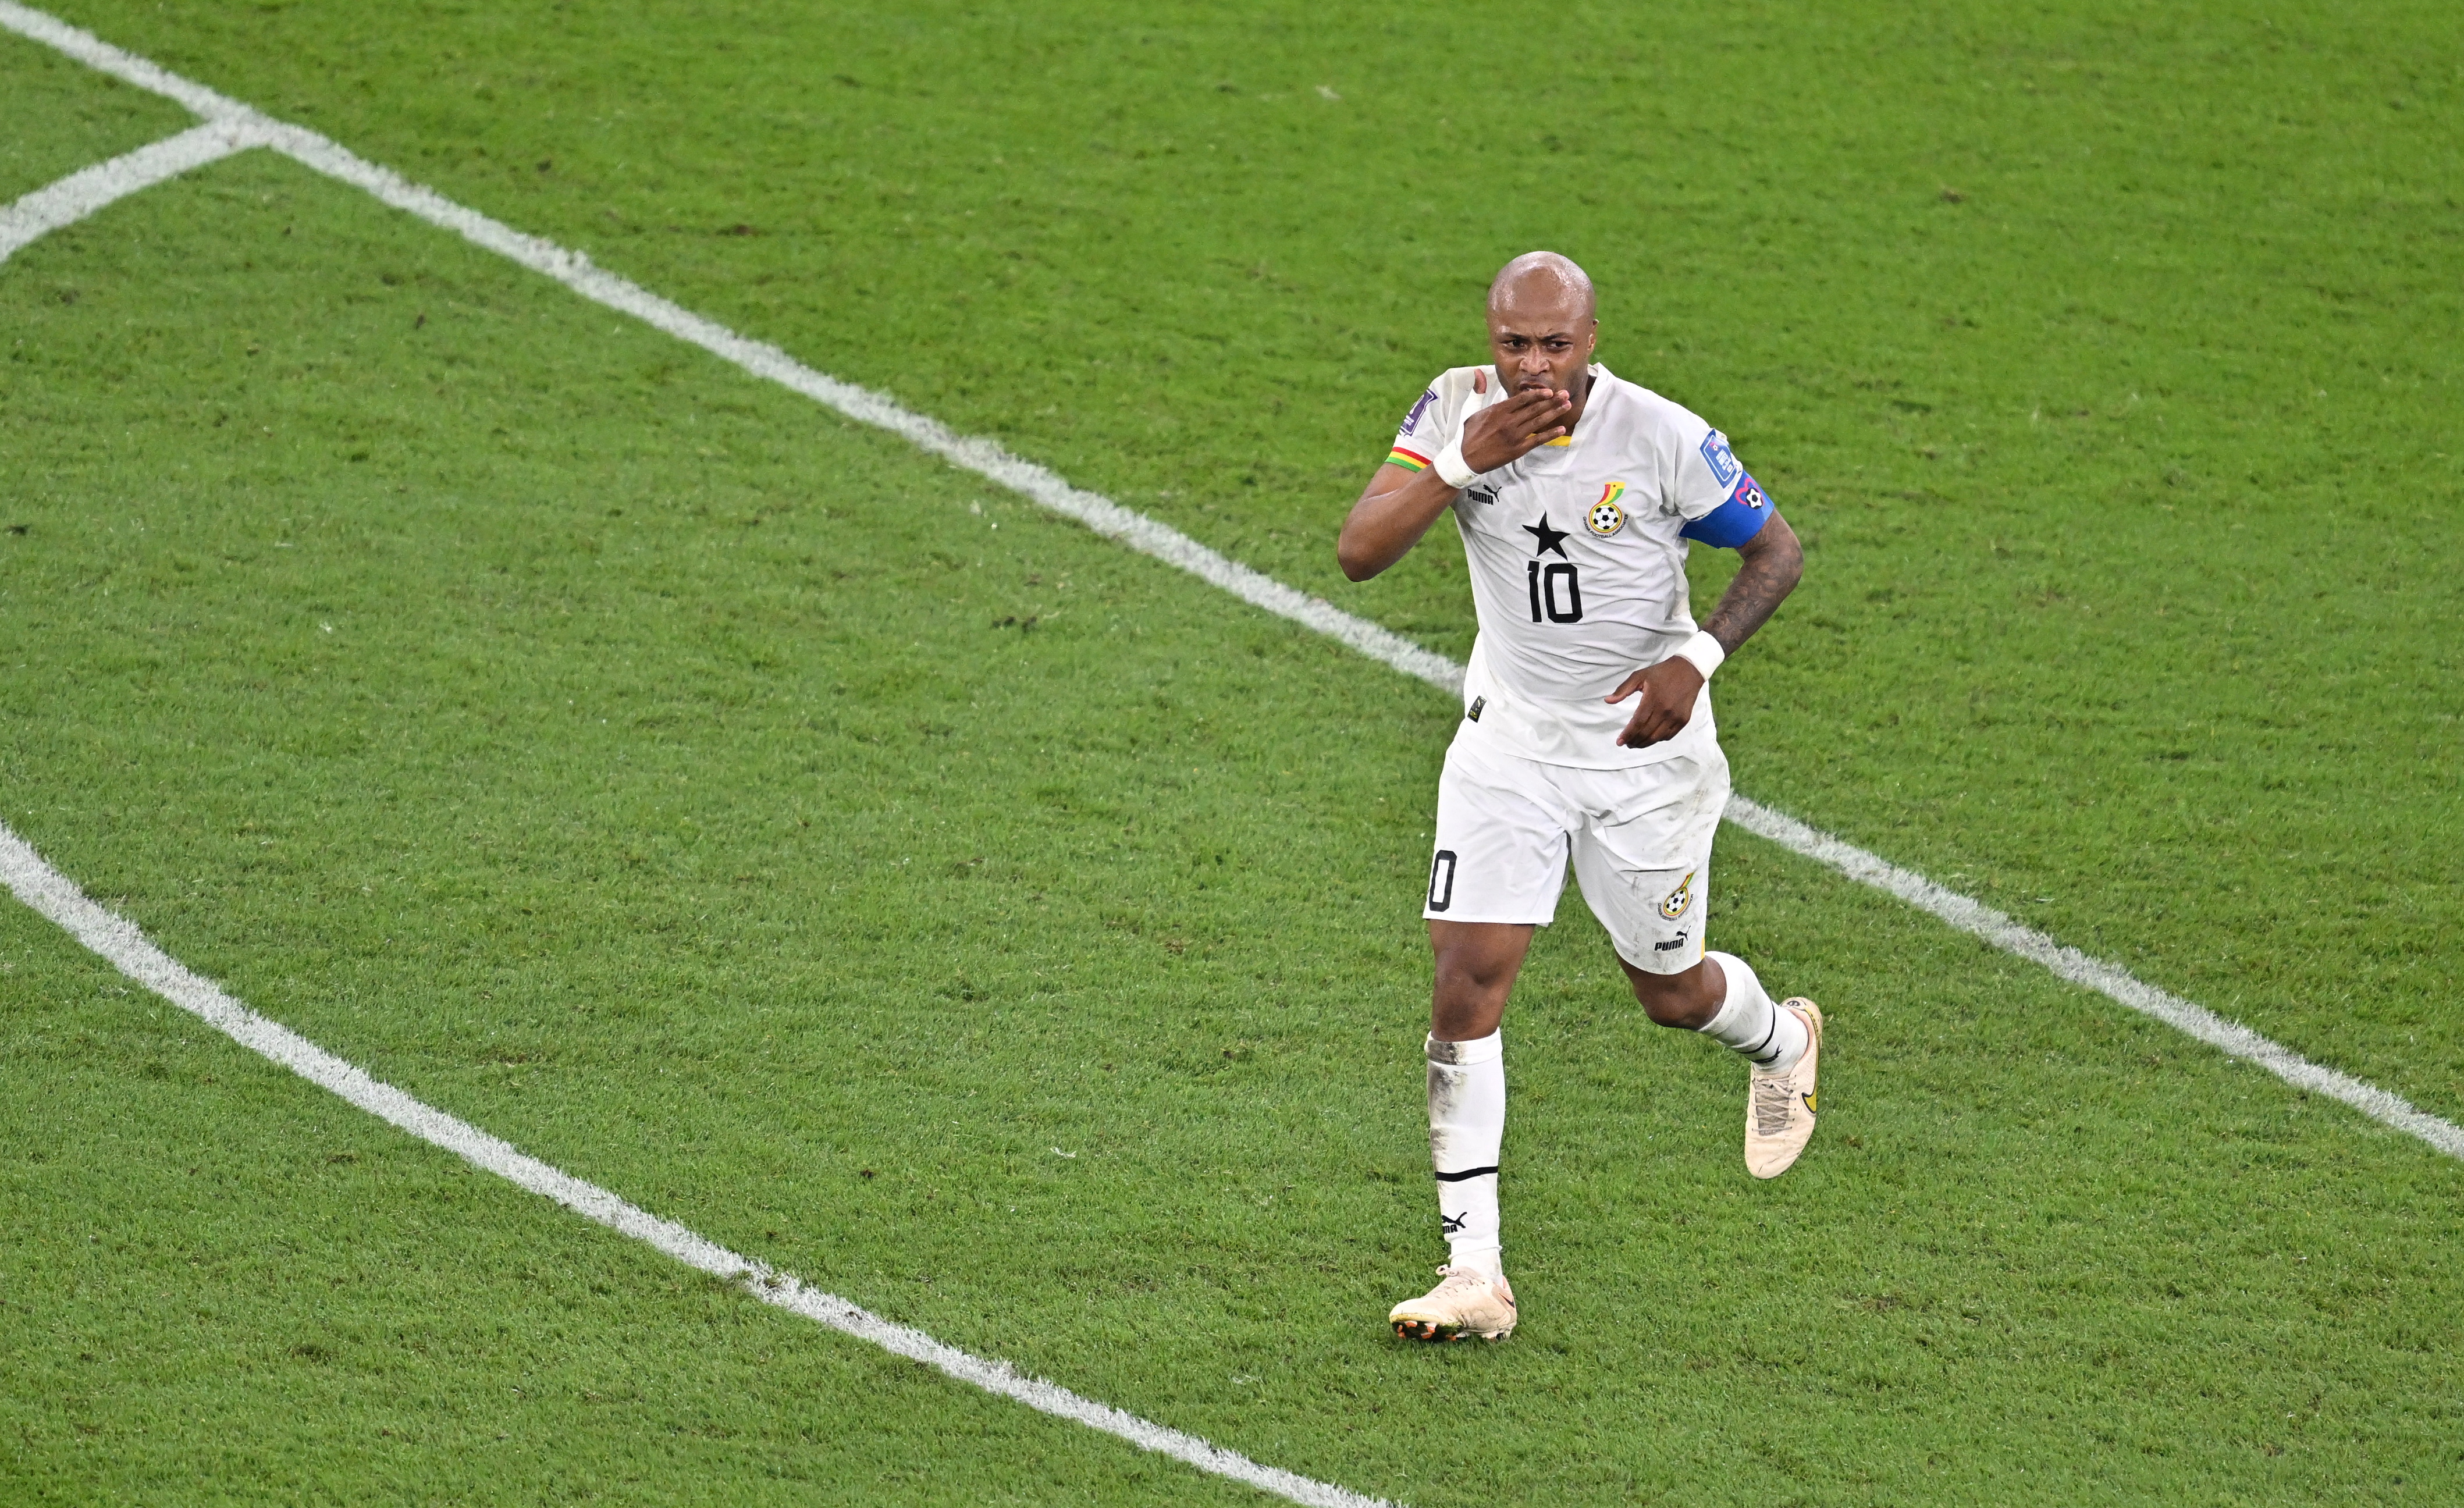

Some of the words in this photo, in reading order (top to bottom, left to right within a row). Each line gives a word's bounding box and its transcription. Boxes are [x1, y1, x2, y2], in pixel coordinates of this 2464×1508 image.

[1467, 488, 1494, 506] PUMA
[1583, 516, 1591, 532] GHANA
[1590, 531, 1612, 539] FOOTBALL
[1527, 560, 1583, 623] 10
[1428, 849, 1457, 912] 0
[1654, 938, 1684, 951] PUMA
